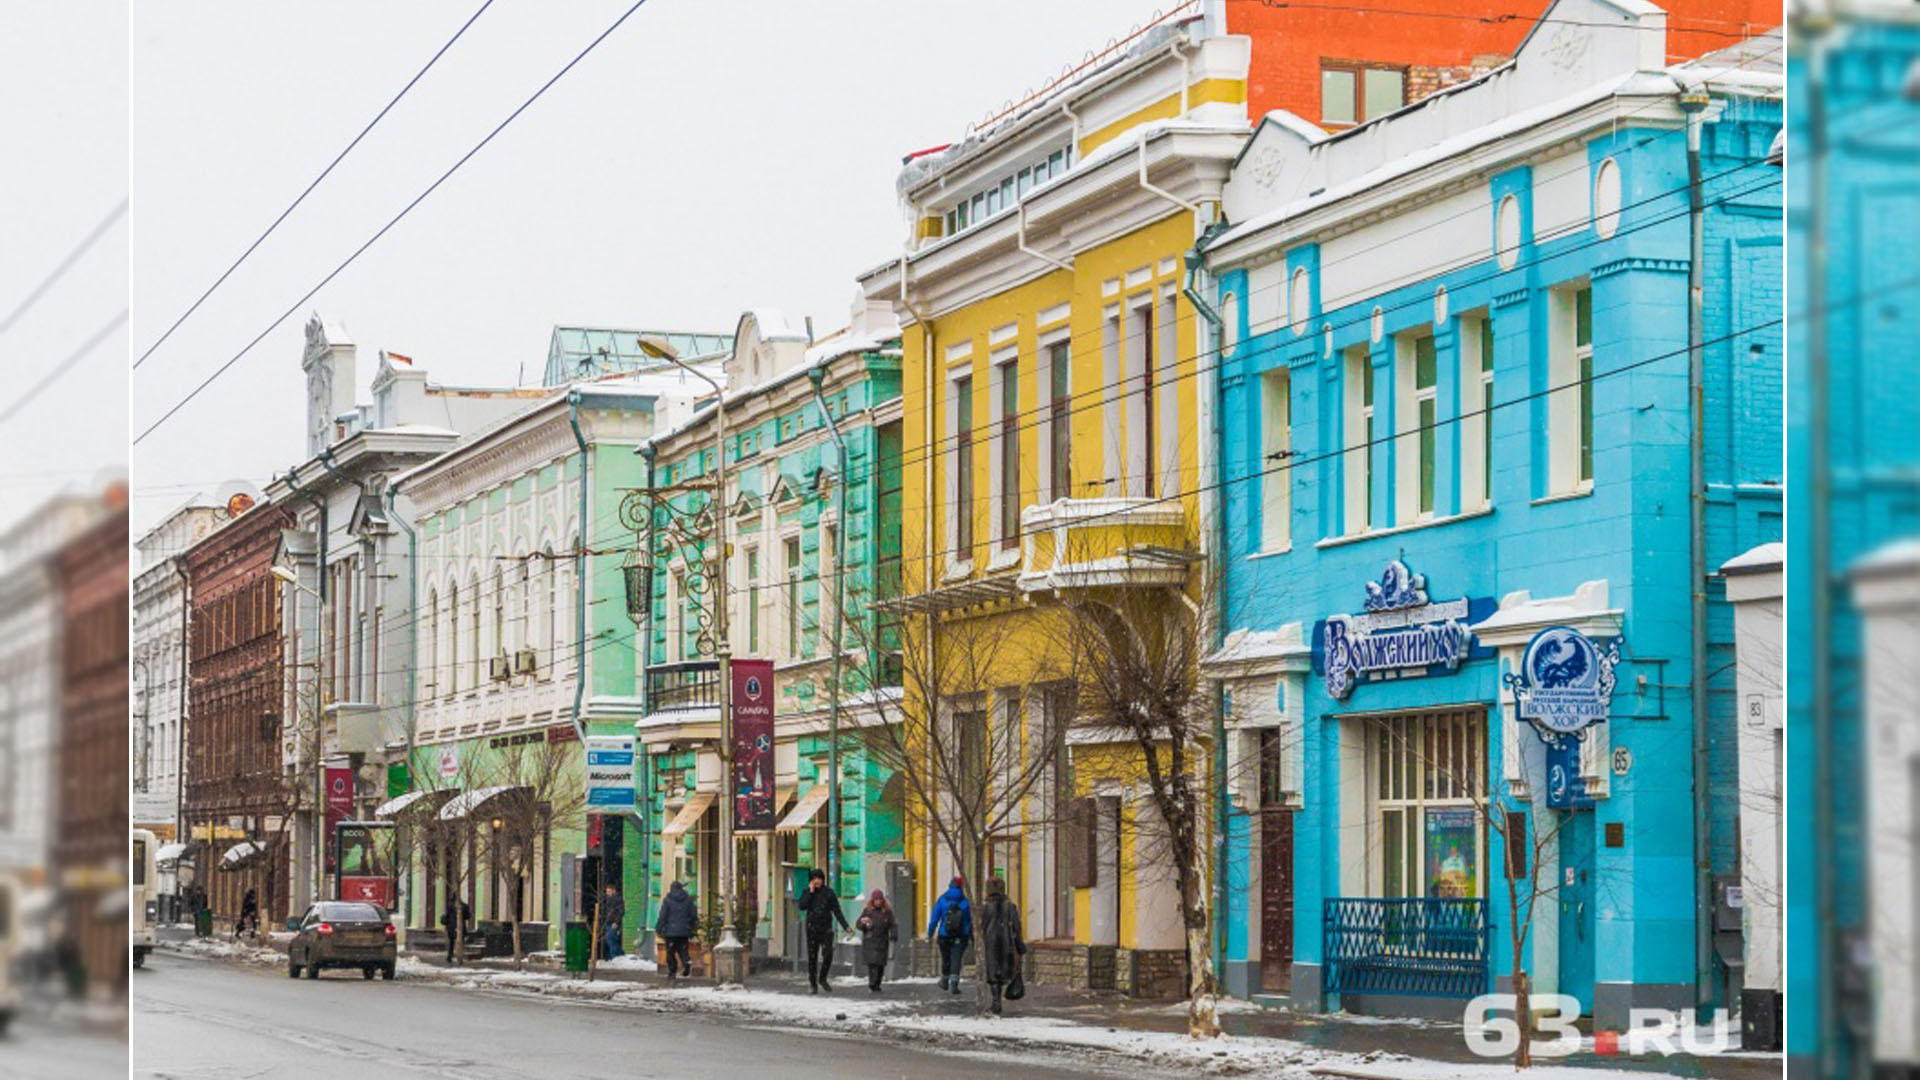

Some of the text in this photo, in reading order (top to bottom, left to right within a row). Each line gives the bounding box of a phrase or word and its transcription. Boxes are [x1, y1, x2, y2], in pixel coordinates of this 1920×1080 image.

[1527, 702, 1605, 716] ВОЛЖСКИЙ
[1552, 715, 1580, 727] ХОР
[1614, 750, 1628, 771] 65
[589, 771, 632, 780] Microsoft
